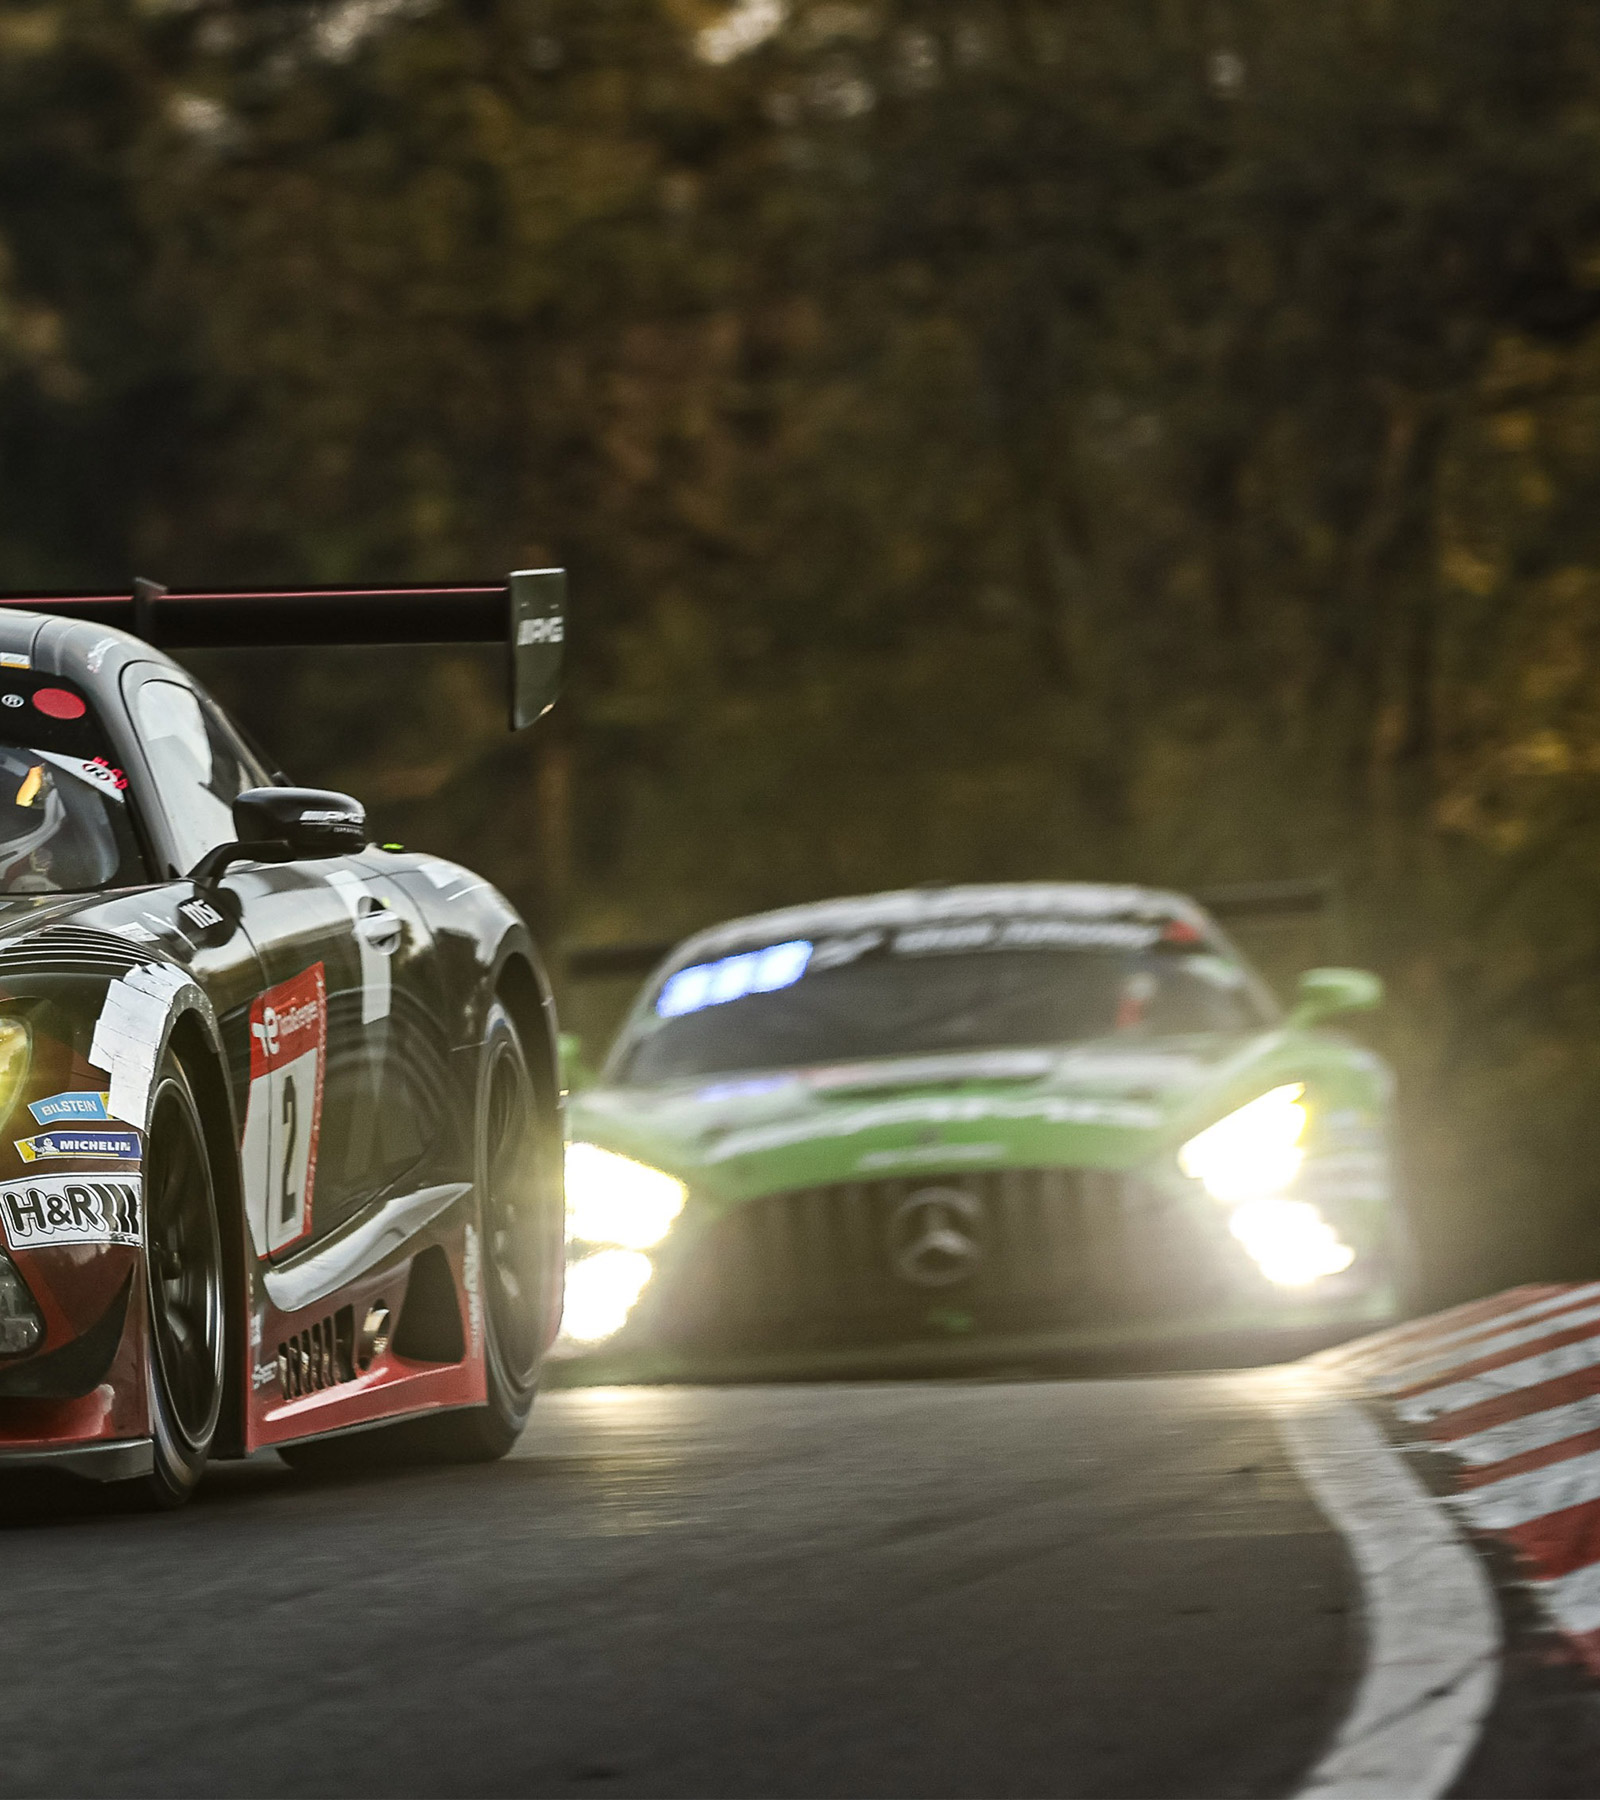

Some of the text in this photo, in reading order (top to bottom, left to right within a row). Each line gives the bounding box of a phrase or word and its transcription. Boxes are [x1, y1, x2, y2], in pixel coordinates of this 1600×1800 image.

[41, 1100, 98, 1116] BILSTEIN
[59, 1140, 131, 1152] MICHELIN
[282, 1075, 297, 1224] 2
[4, 1184, 105, 1237] H&R
